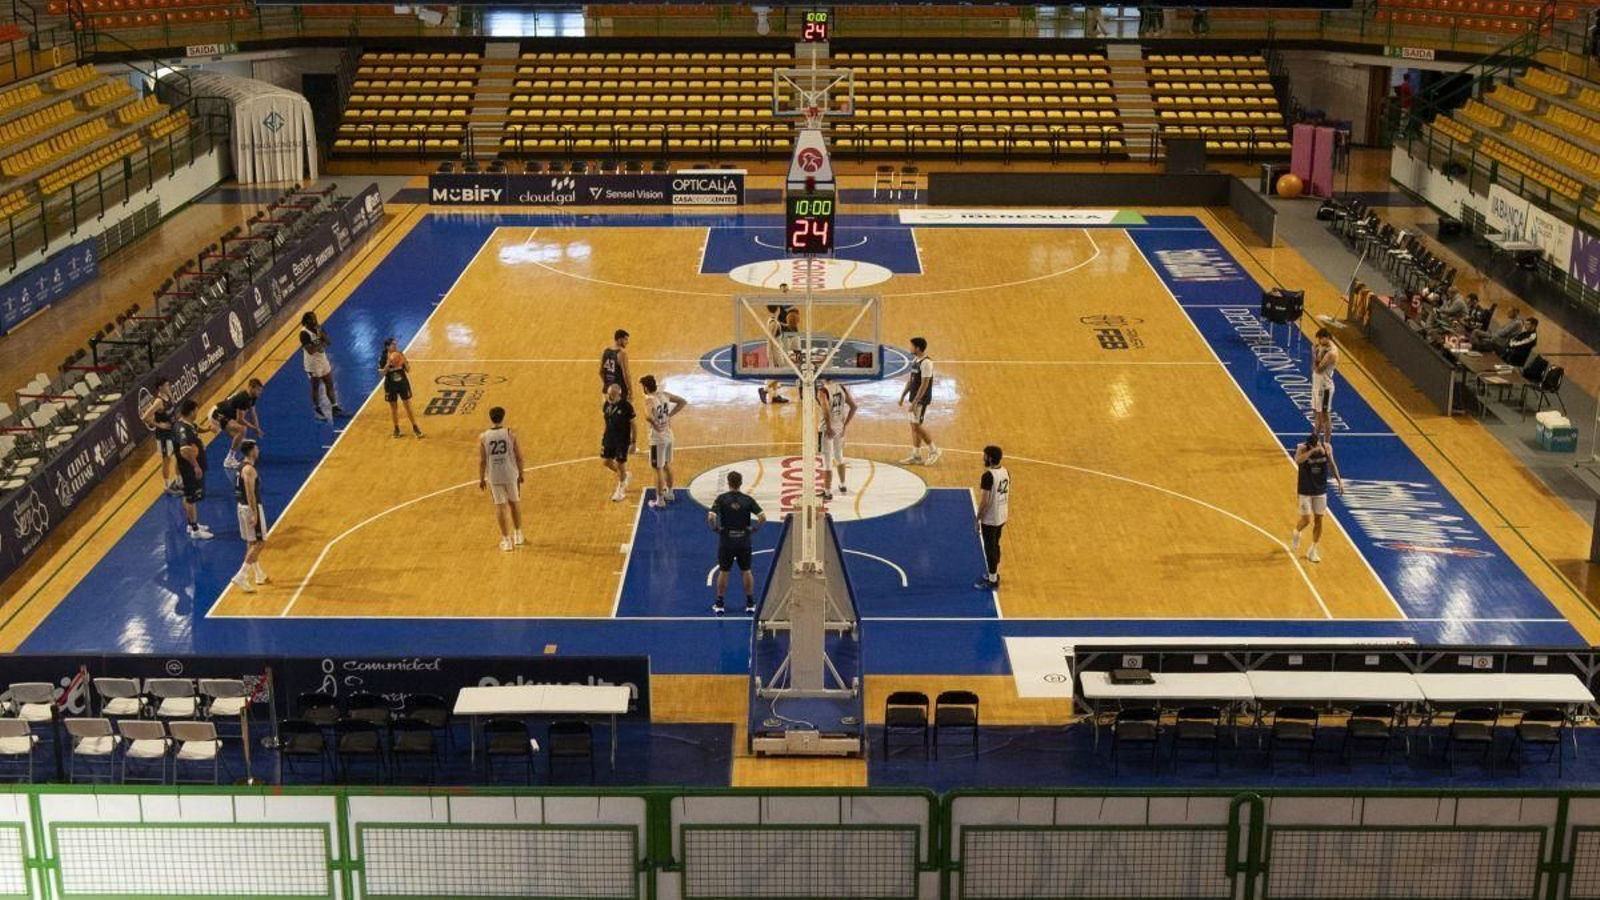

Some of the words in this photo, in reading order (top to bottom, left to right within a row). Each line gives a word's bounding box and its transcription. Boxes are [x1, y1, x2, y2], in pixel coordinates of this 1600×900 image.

[804, 23, 825, 39] 24
[519, 190, 576, 205] cloud.gal
[605, 189, 635, 200] Sensei
[637, 189, 664, 200] Vision
[795, 200, 831, 215] 10:00
[792, 219, 828, 247] 24
[490, 440, 507, 455] 23
[343, 657, 441, 671] Comunidad
